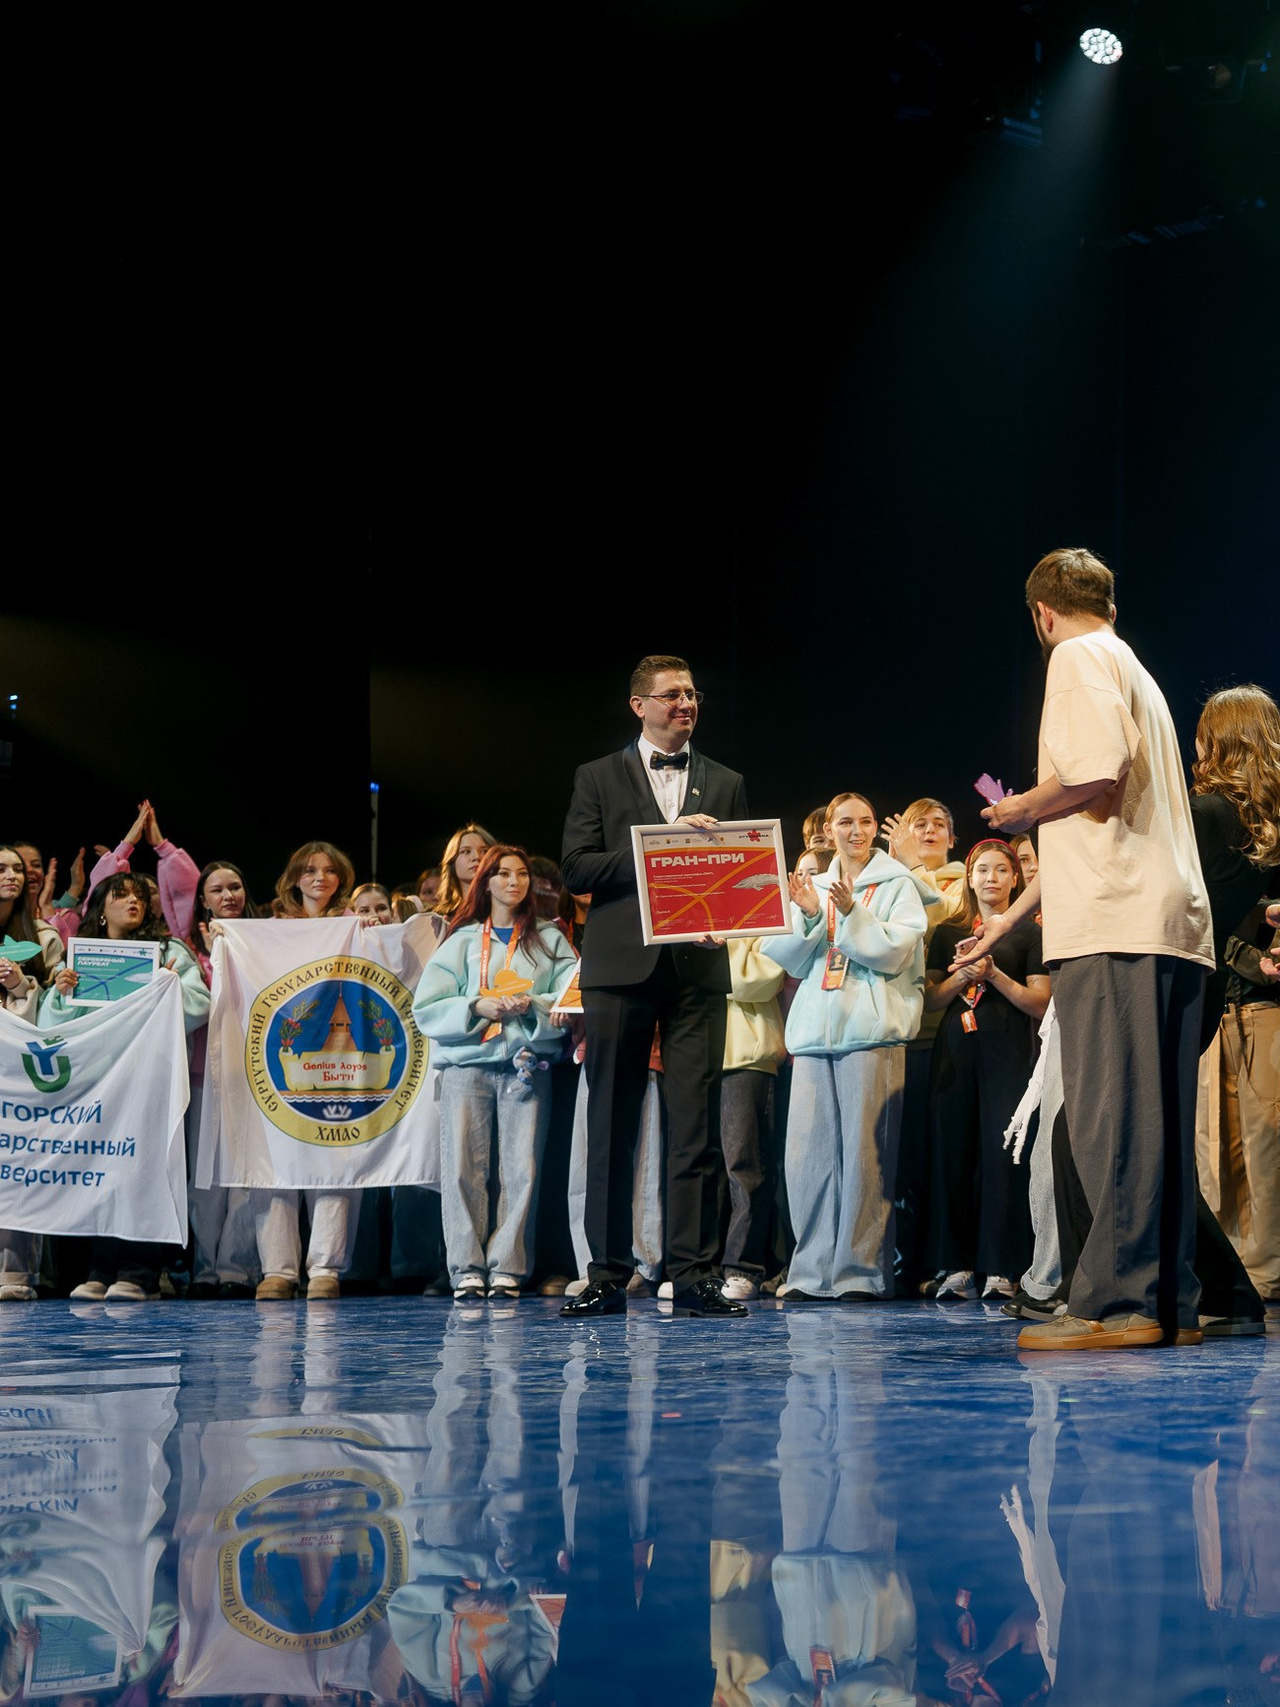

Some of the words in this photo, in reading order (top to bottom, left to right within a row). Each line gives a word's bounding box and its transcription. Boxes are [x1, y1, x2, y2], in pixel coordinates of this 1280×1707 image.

[650, 852, 745, 868] ГРАН-ПРИ
[263, 961, 400, 1009] ГОСУДАРСТВЕННЫЙ
[250, 1012, 279, 1112] СУРГУТСКИЙ
[303, 1062, 336, 1071] Genius
[315, 1126, 360, 1142] ХМАО
